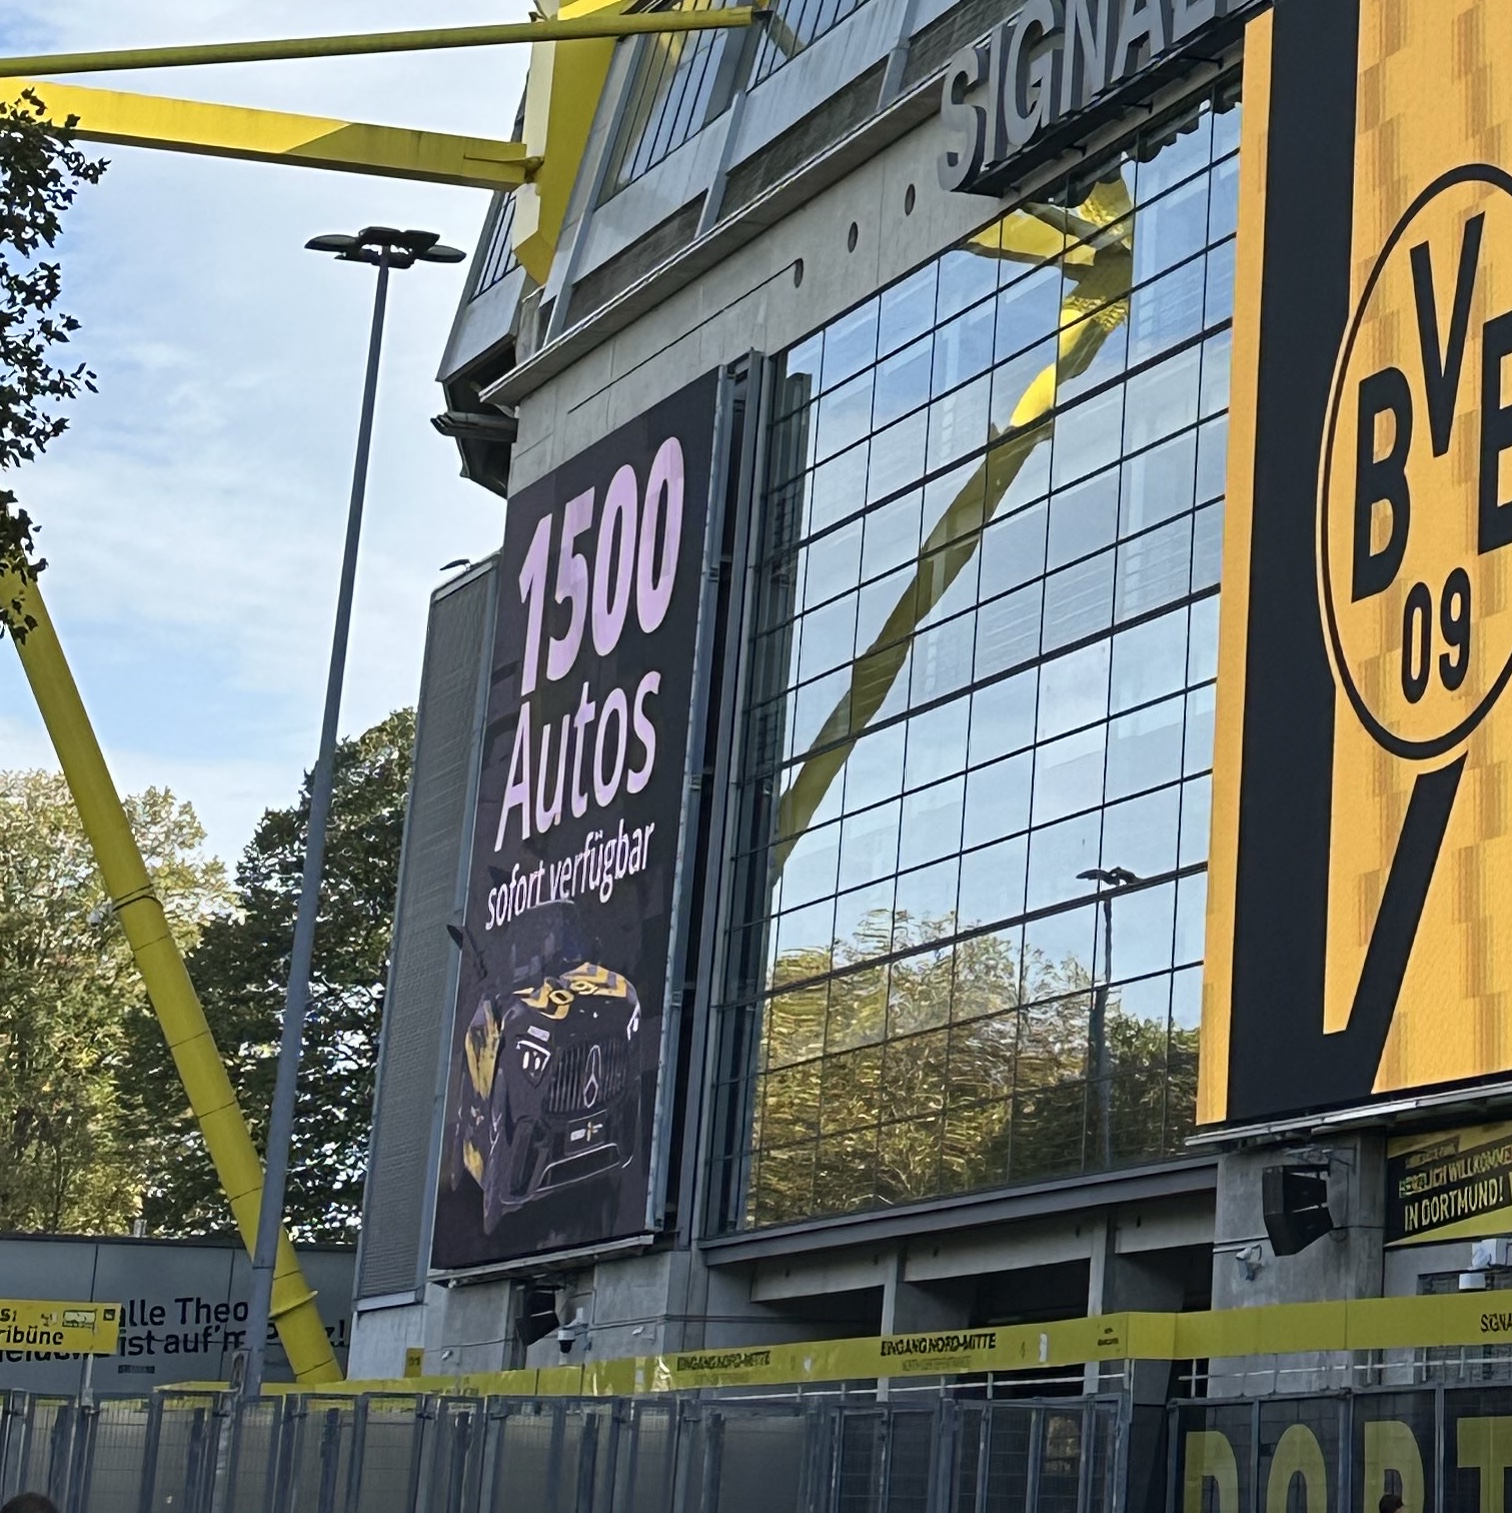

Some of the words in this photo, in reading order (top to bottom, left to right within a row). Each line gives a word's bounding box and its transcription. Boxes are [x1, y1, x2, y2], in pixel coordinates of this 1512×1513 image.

[518, 436, 685, 697] 1500
[1401, 566, 1473, 705] 09
[494, 670, 662, 853] Autos
[485, 854, 545, 931] sofort
[549, 818, 656, 904] verfügbar
[1403, 1202, 1419, 1233] IN
[1420, 1175, 1504, 1226] DORTMUND!
